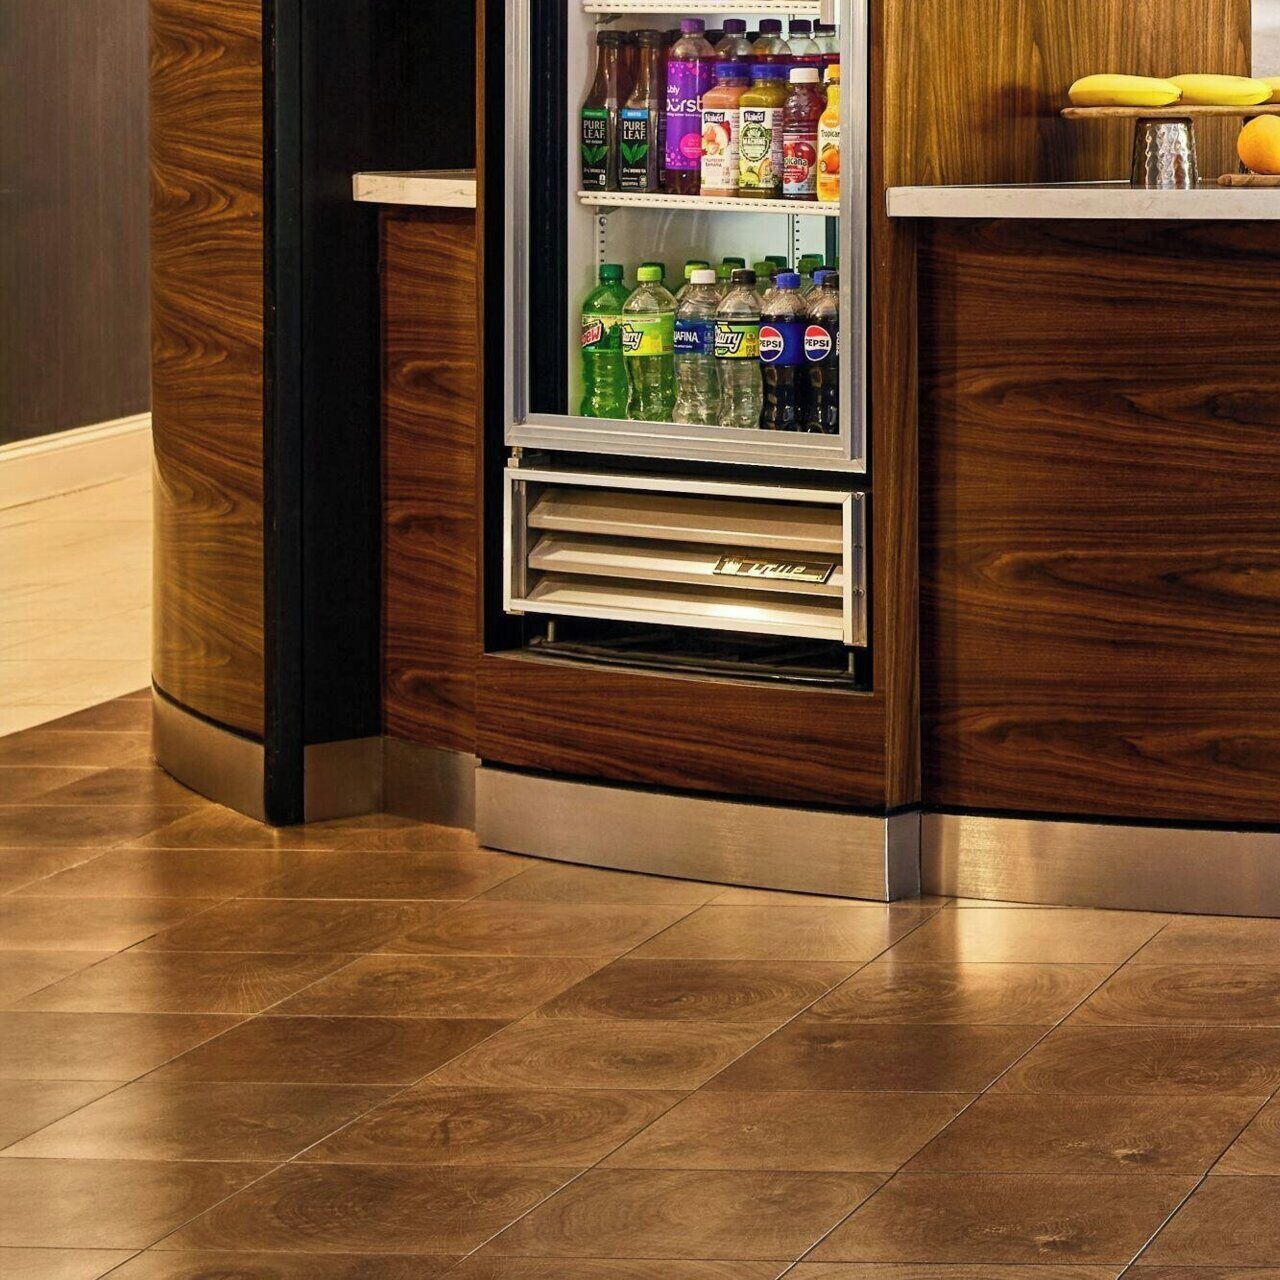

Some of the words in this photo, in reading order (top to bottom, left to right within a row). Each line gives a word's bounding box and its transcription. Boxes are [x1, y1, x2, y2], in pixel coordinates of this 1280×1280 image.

[583, 120, 605, 129] PURE
[623, 121, 646, 130] PURE
[584, 130, 605, 139] LEAF
[623, 131, 646, 140] LEAF
[806, 339, 829, 347] PEPSI
